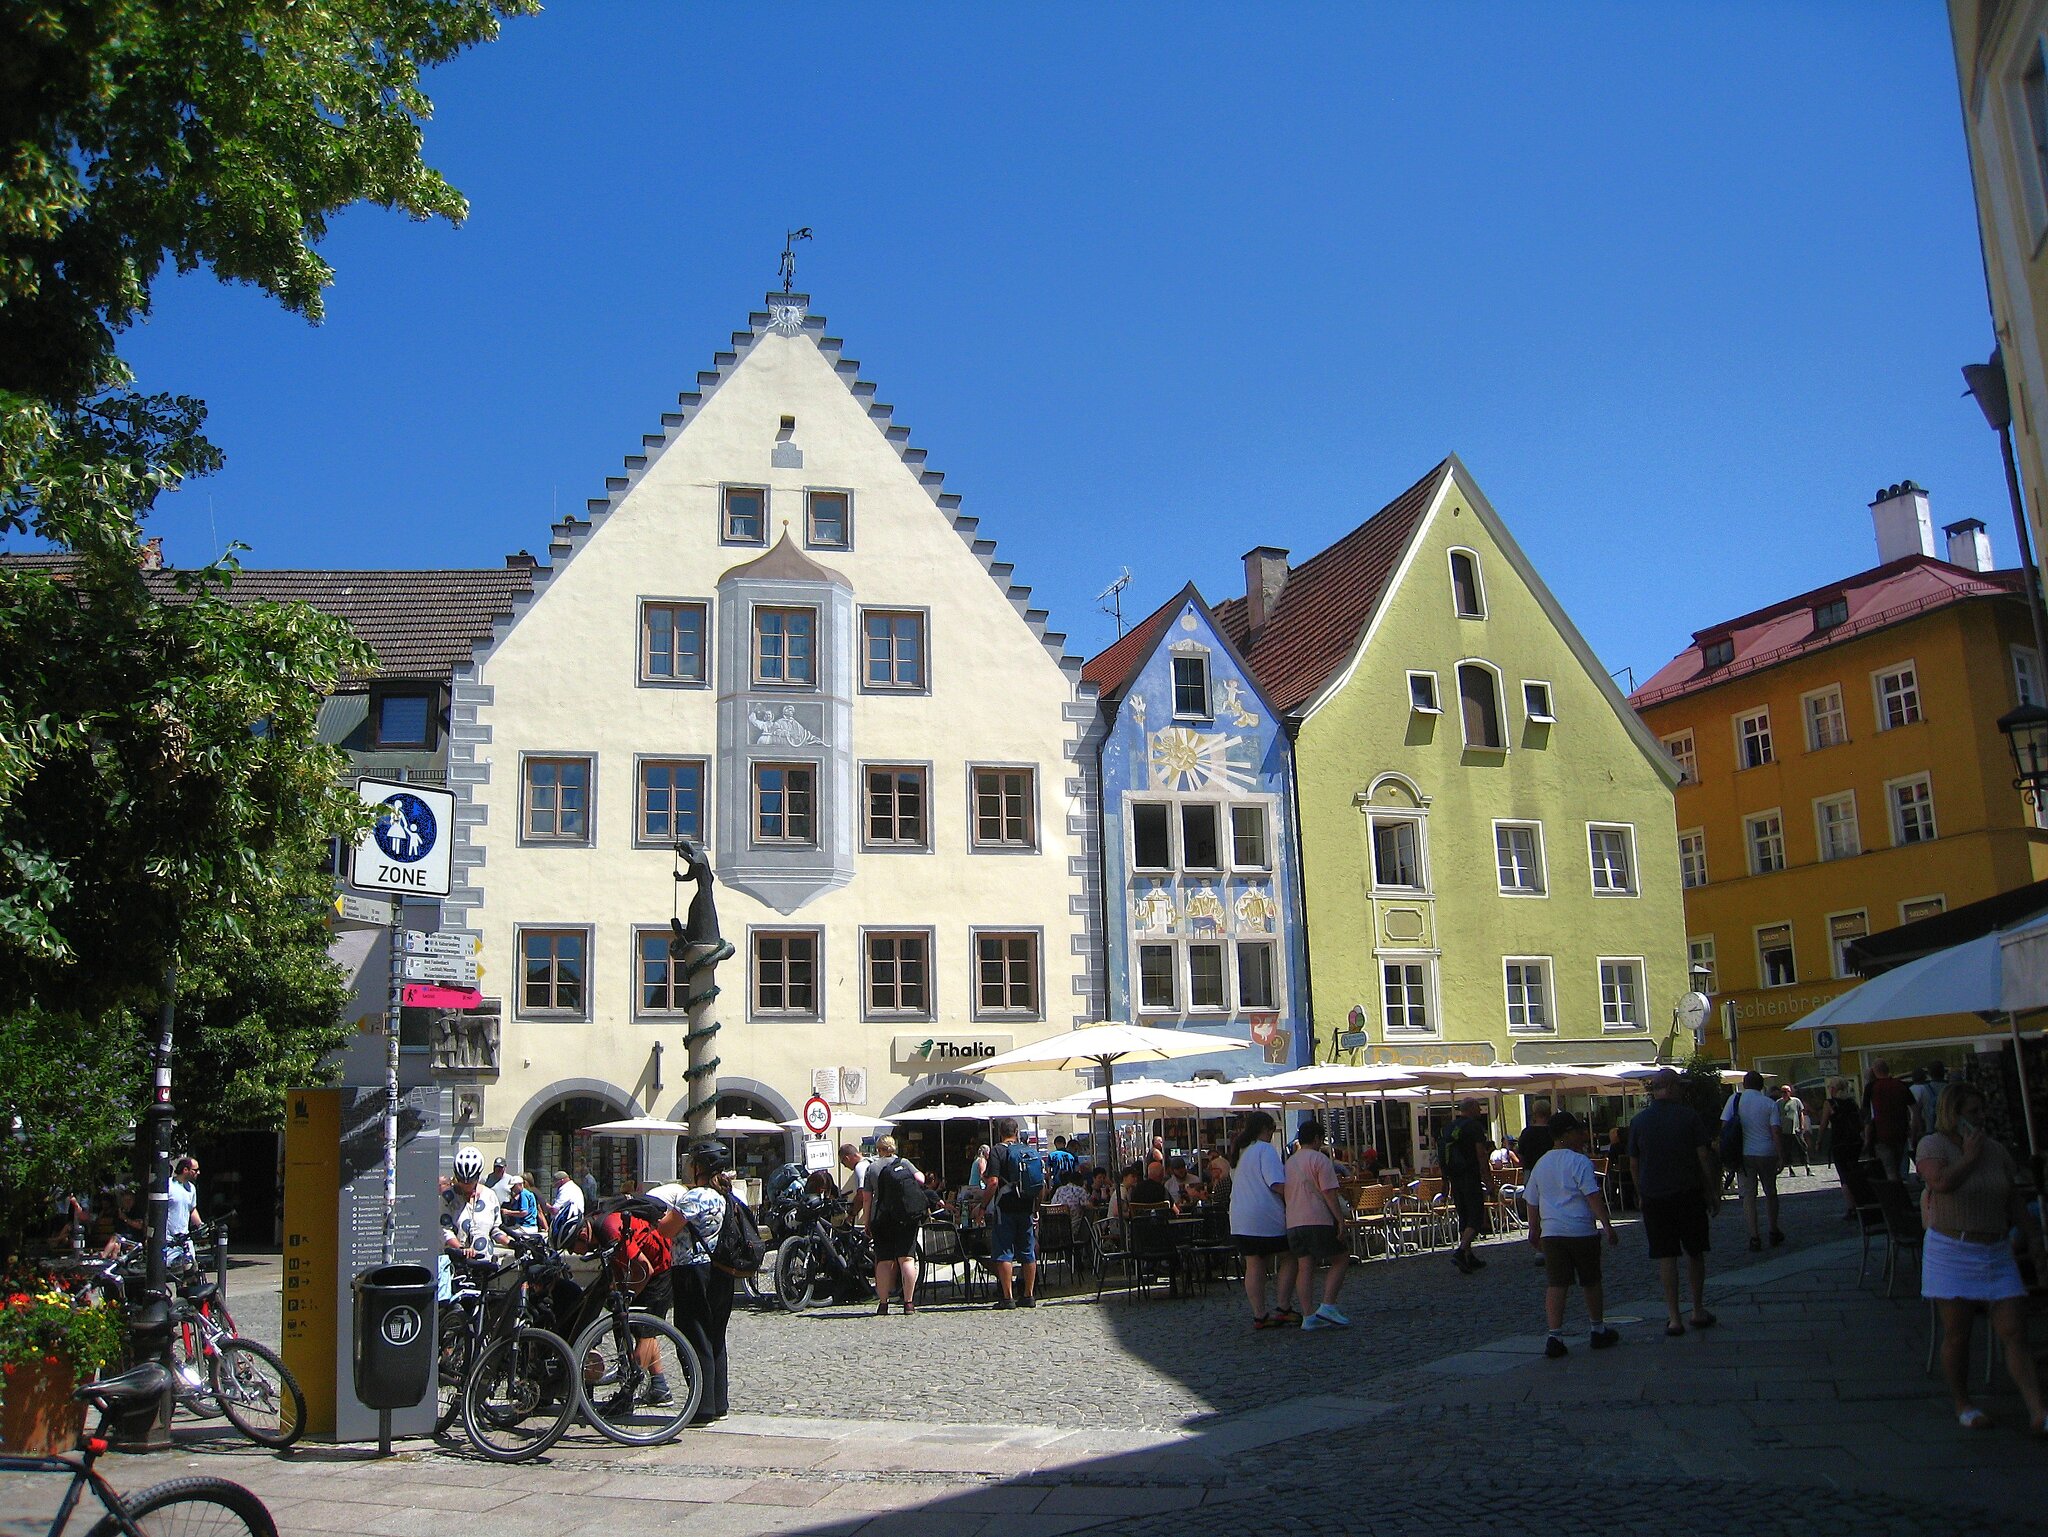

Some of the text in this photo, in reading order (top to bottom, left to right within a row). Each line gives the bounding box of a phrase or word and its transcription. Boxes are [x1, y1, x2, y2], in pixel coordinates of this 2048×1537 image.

[378, 865, 427, 886] ZONE
[1735, 992, 1833, 1019] schenbren
[937, 1042, 996, 1057] Thalia
